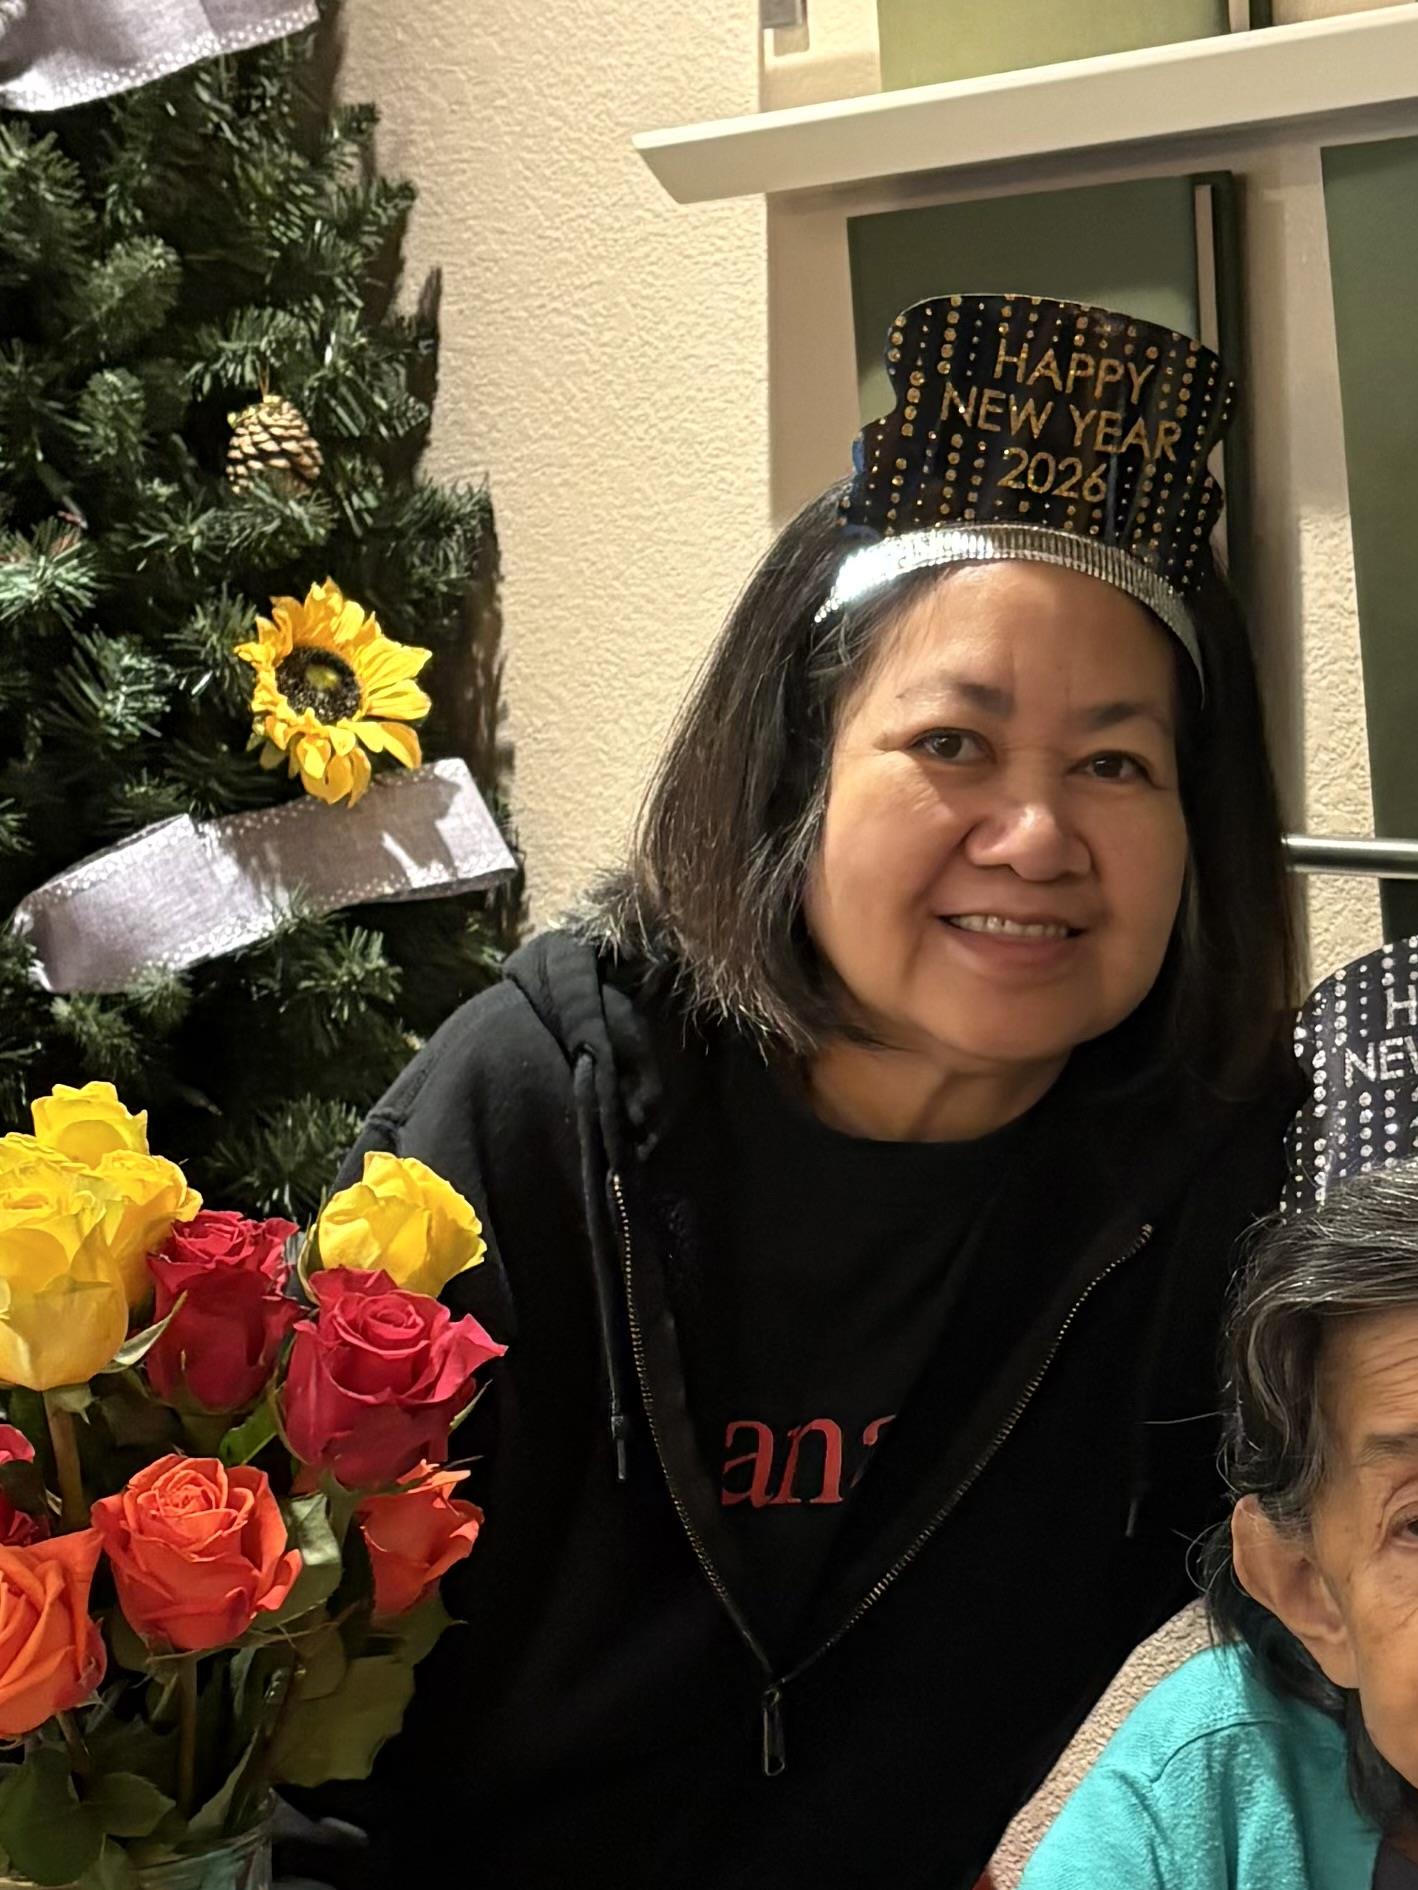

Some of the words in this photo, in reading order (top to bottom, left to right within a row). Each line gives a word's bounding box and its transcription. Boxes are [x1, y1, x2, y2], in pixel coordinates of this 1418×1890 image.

[993, 338, 1154, 404] HAPPY
[940, 382, 1053, 439] NEW
[1069, 403, 1181, 462] YEAR
[997, 448, 1107, 503] 2026
